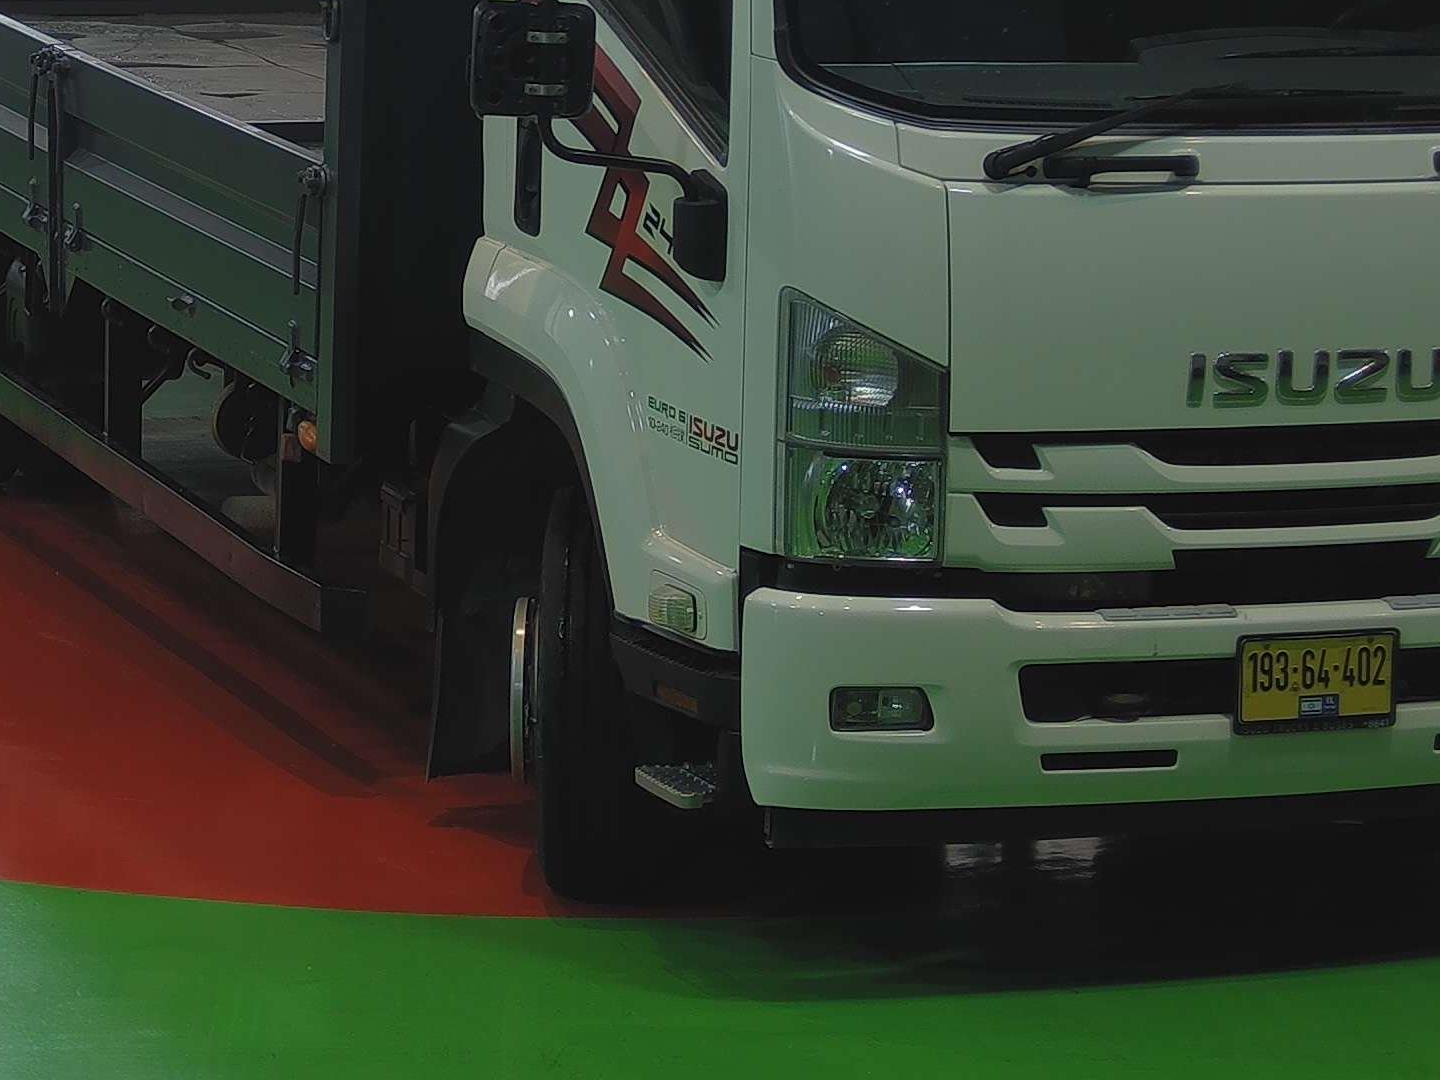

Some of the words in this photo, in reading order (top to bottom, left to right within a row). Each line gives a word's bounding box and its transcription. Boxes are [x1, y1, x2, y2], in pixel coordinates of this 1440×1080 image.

[1186, 348, 1440, 408] ISUZU
[648, 396, 676, 419] EURO
[690, 415, 739, 451] ISUZU
[689, 436, 738, 465] SUMO
